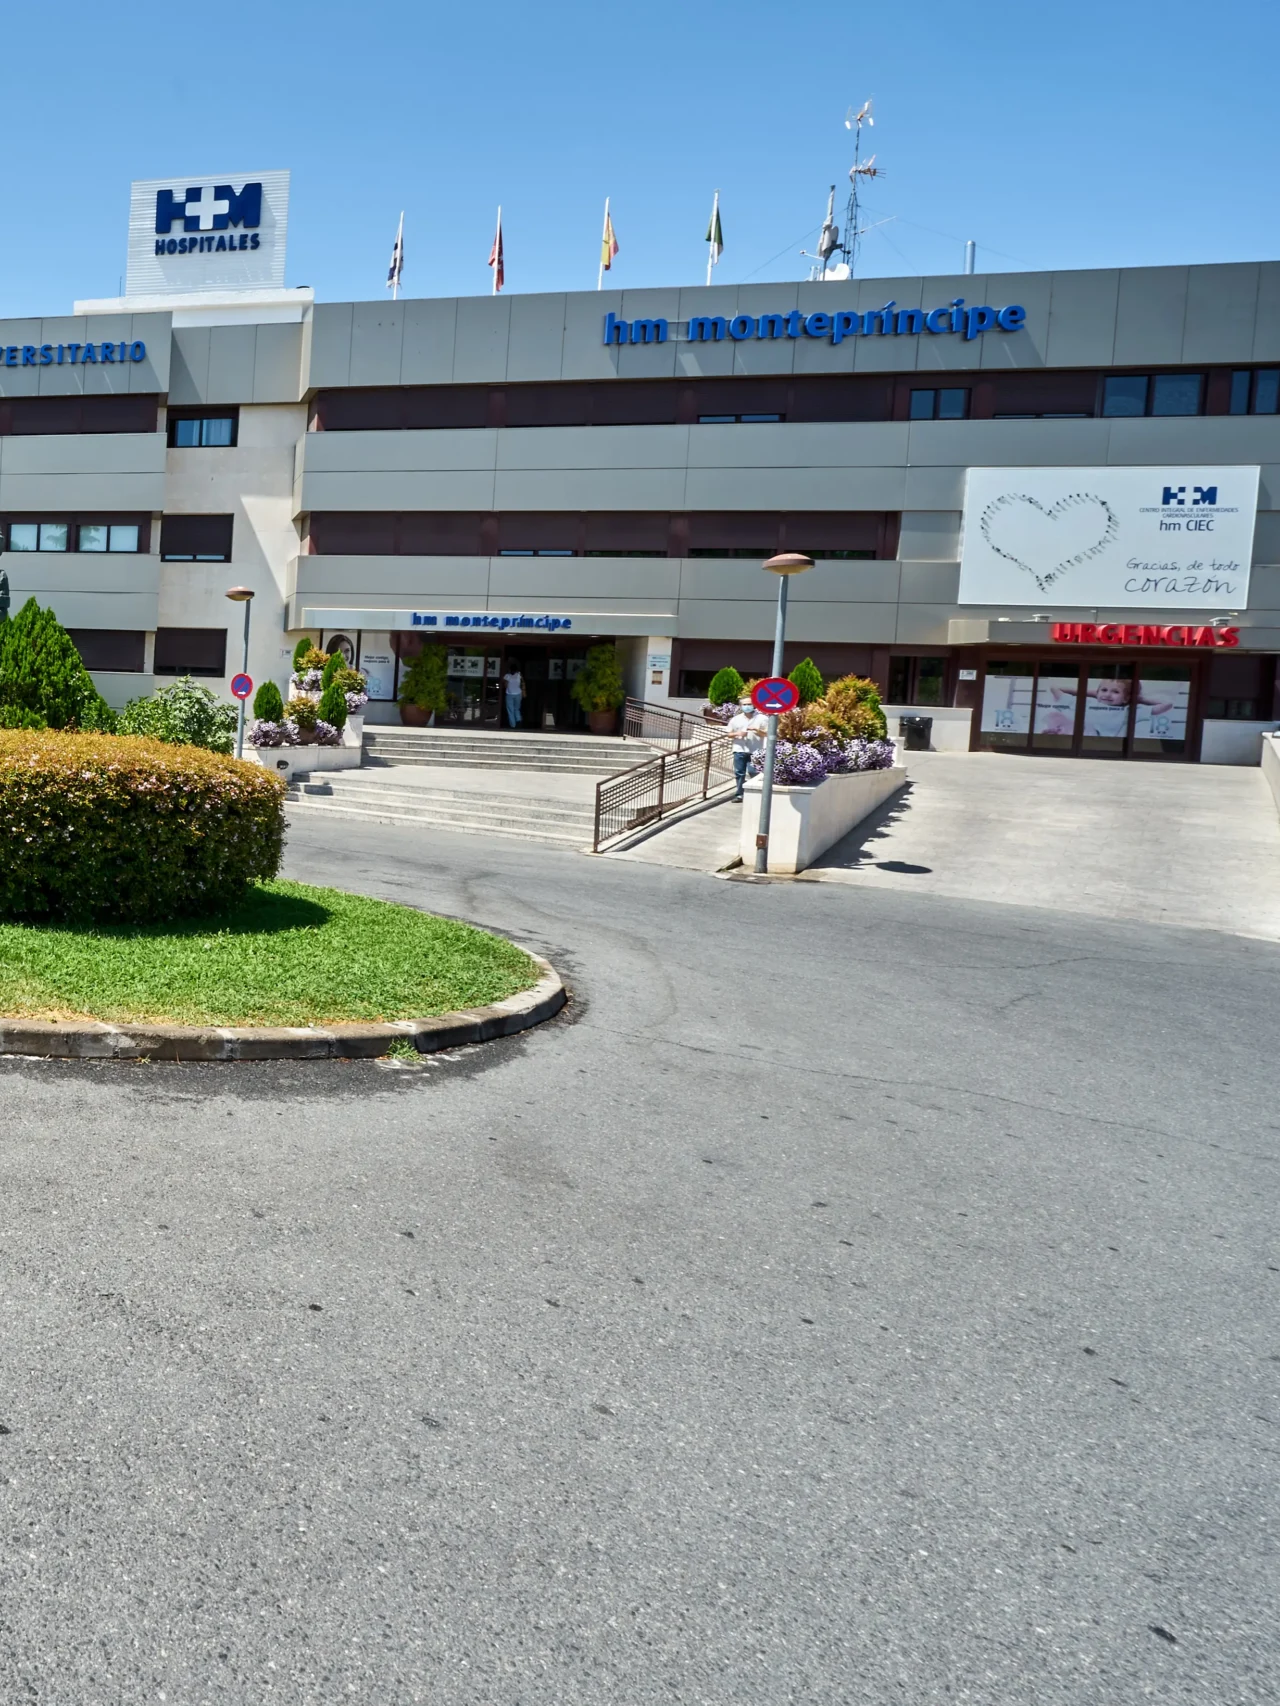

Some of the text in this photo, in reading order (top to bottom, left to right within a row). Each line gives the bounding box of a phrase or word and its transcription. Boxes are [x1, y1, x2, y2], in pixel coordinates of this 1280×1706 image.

[155, 233, 260, 255] HOSPITALES
[603, 297, 1027, 345] hm montepríncipe
[1160, 519, 1214, 531] hm CIEC
[1126, 557, 1240, 571] Gracias, de todo
[1124, 575, 1237, 593] corazón
[411, 612, 437, 626] hm
[1052, 623, 1240, 647] URGENCIAS
